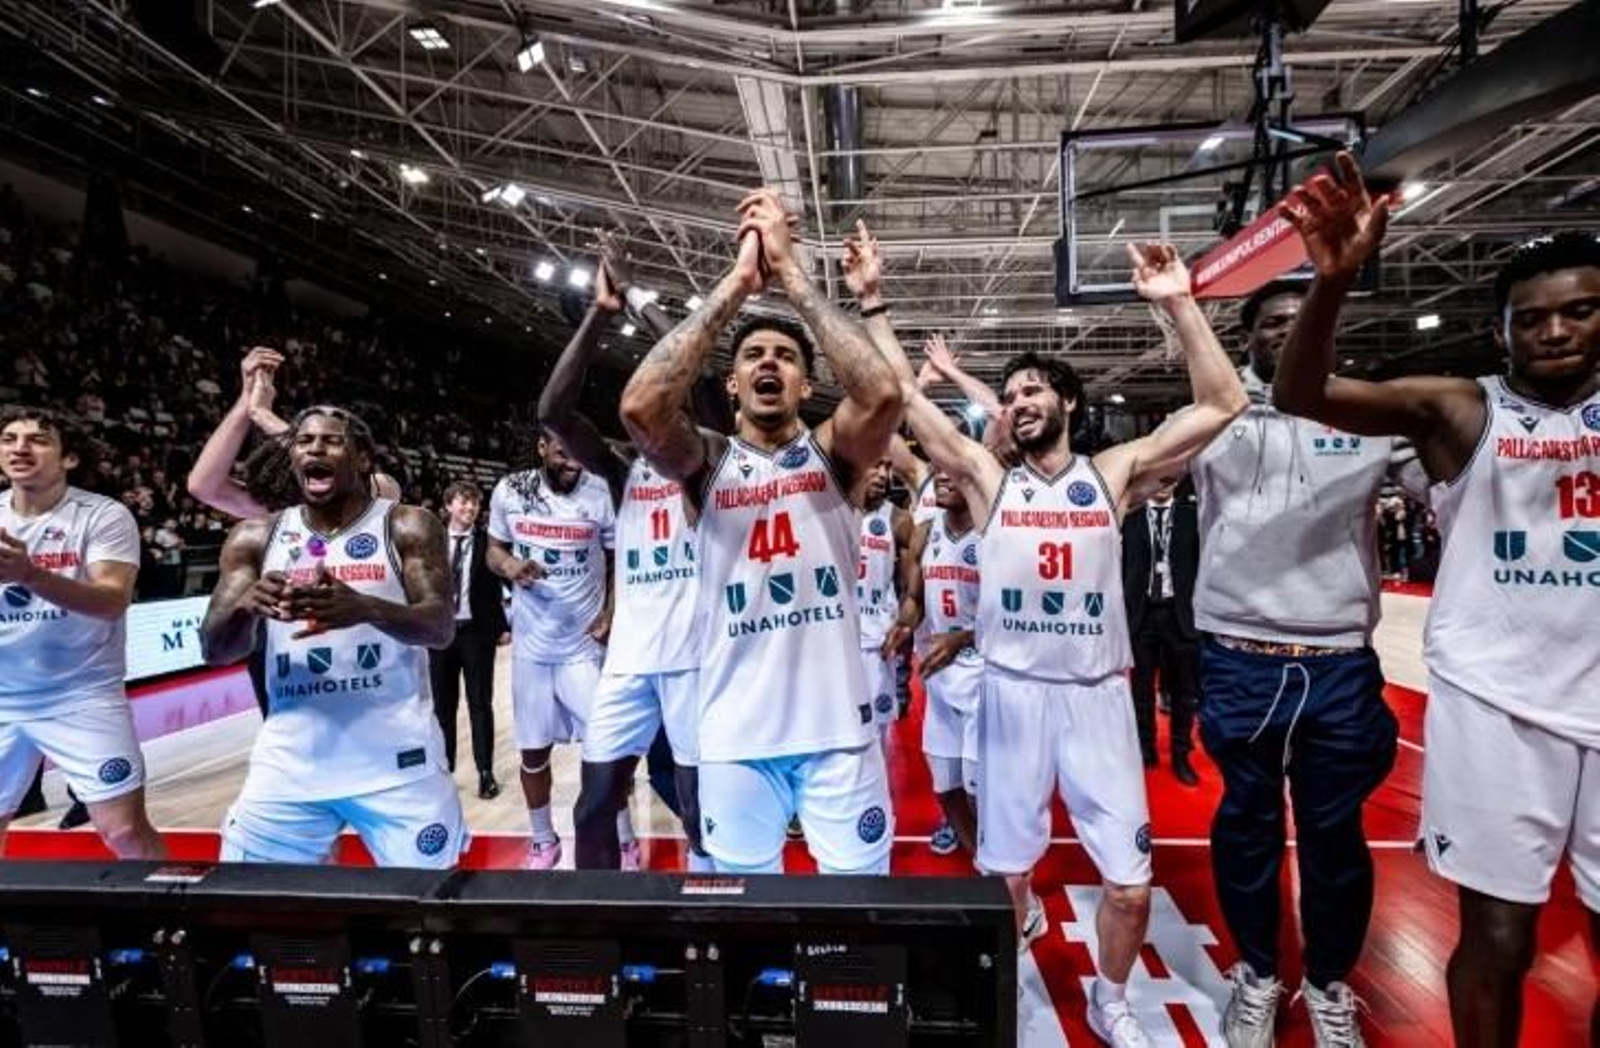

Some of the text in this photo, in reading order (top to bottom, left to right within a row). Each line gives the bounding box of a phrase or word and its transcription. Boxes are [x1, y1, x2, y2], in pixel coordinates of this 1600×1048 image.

[1555, 471, 1600, 519] 13
[650, 508, 670, 540] 11
[748, 511, 800, 562] 44
[1038, 541, 1072, 580] 31
[728, 603, 844, 637] UNAHOTELS
[942, 589, 957, 618] 5
[1002, 617, 1104, 635] UNAHOTELS
